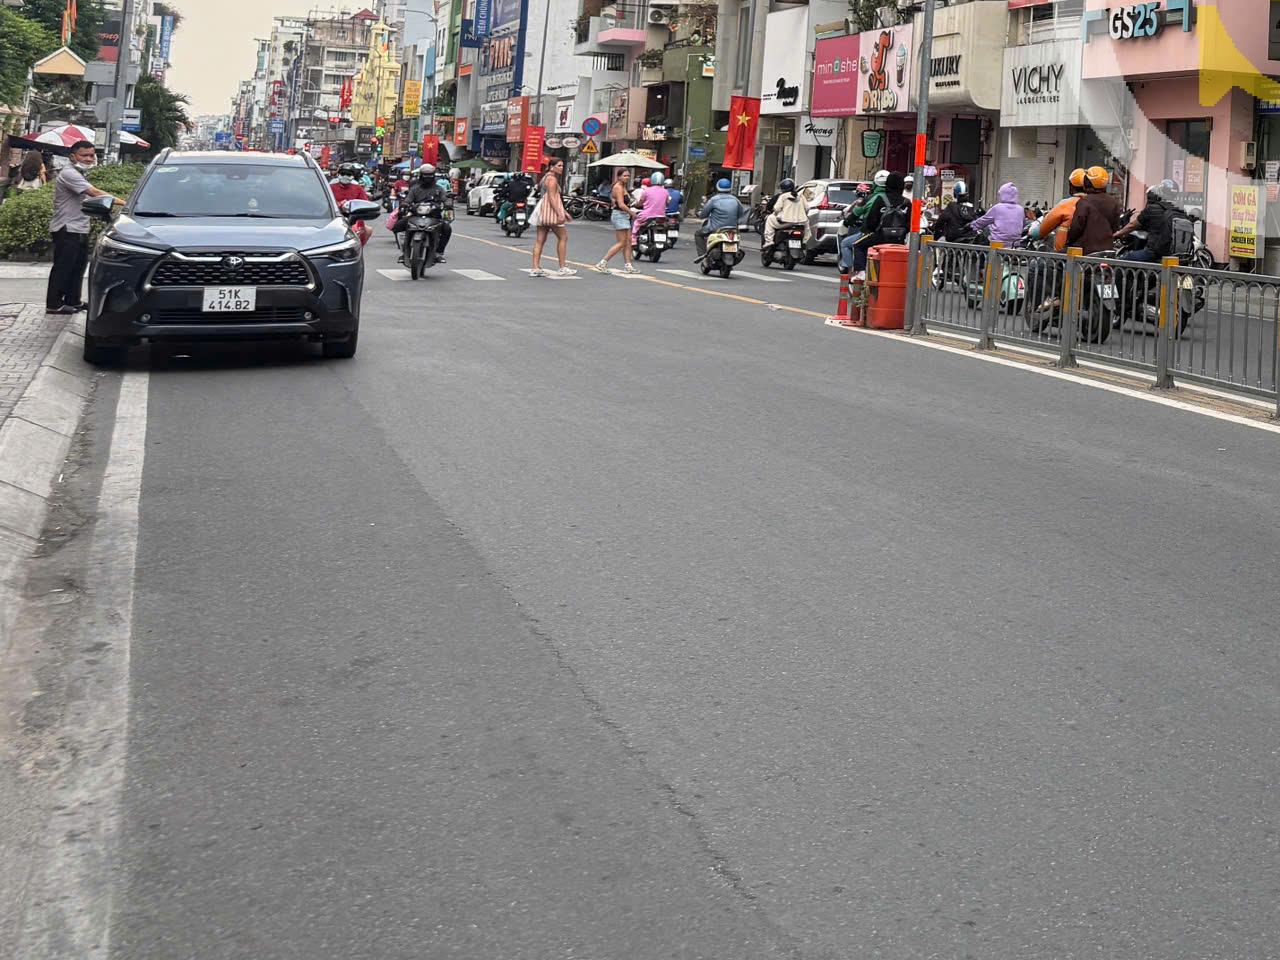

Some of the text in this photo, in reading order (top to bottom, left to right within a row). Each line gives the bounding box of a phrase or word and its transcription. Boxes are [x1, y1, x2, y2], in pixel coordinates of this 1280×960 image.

[1109, 2, 1160, 40] GS25
[930, 54, 962, 78] UXURY
[1012, 64, 1064, 94] VICHY
[208, 300, 250, 310] 414.82
[219, 289, 242, 300] 51K
